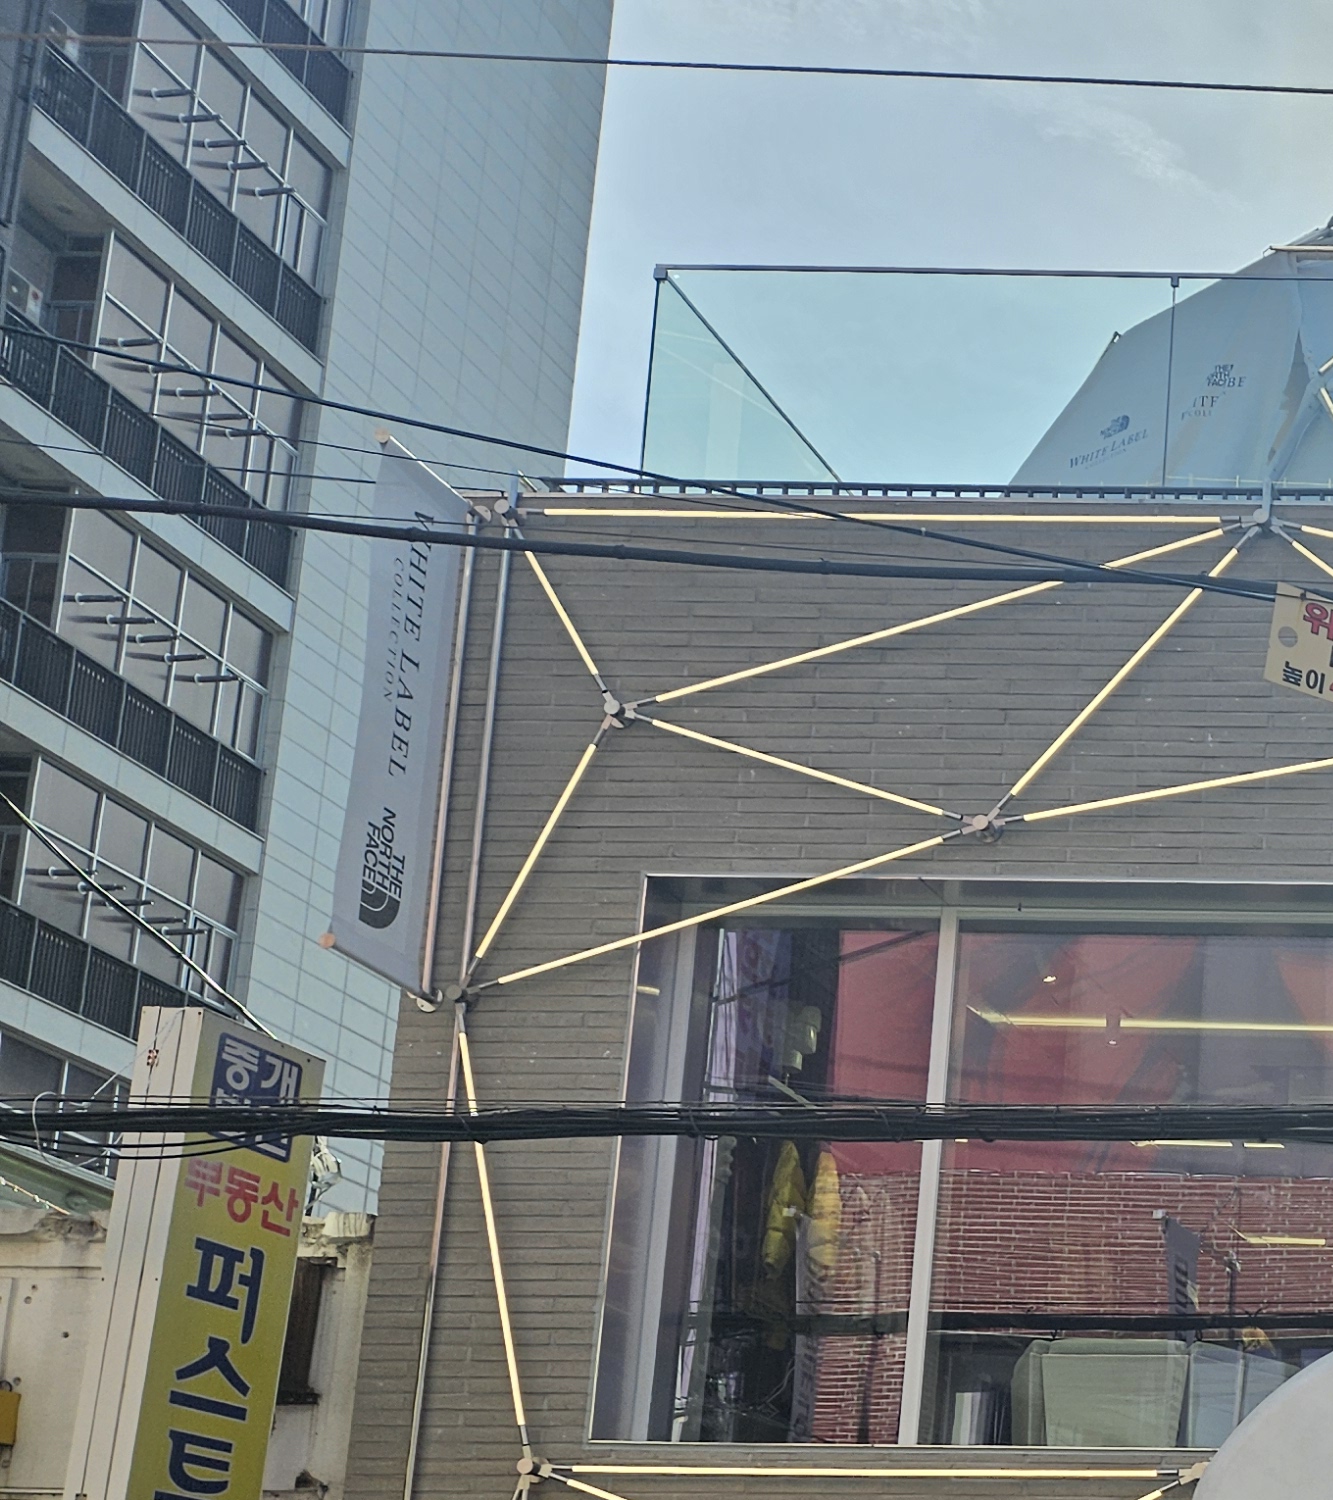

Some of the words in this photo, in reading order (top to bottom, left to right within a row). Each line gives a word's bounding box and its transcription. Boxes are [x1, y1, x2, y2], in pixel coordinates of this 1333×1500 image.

[384, 557, 405, 703] COLLECTION
[388, 649, 420, 777] LABEL
[1282, 661, 1326, 694] 높이
[363, 821, 381, 883] FACE
[376, 806, 397, 892] NORTH
[389, 854, 405, 900] THE
[222, 1038, 298, 1103] 중개
[184, 1157, 299, 1237] 부동산
